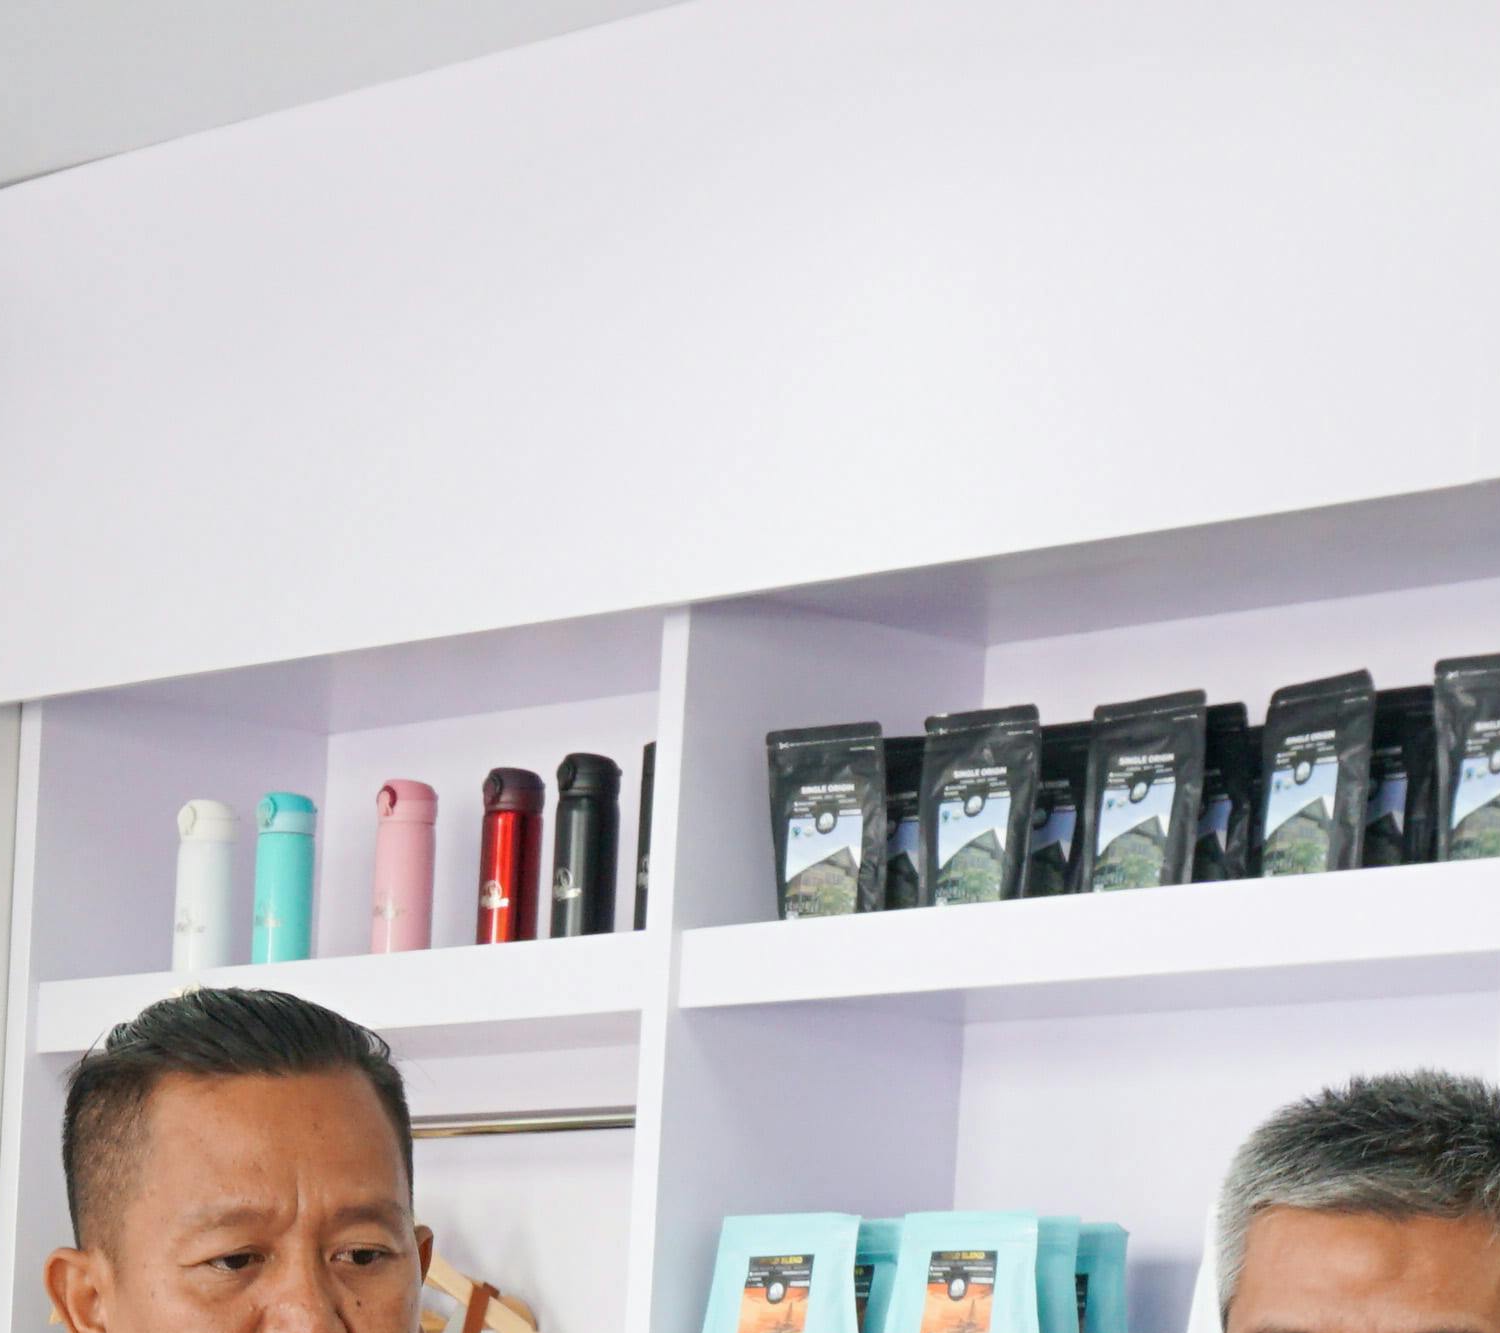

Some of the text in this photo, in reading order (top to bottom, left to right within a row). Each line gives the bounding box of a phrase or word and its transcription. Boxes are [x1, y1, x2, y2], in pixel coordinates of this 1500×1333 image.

[953, 766, 1007, 779] SINGLE ORIGIN
[801, 785, 827, 795] SINGLE
